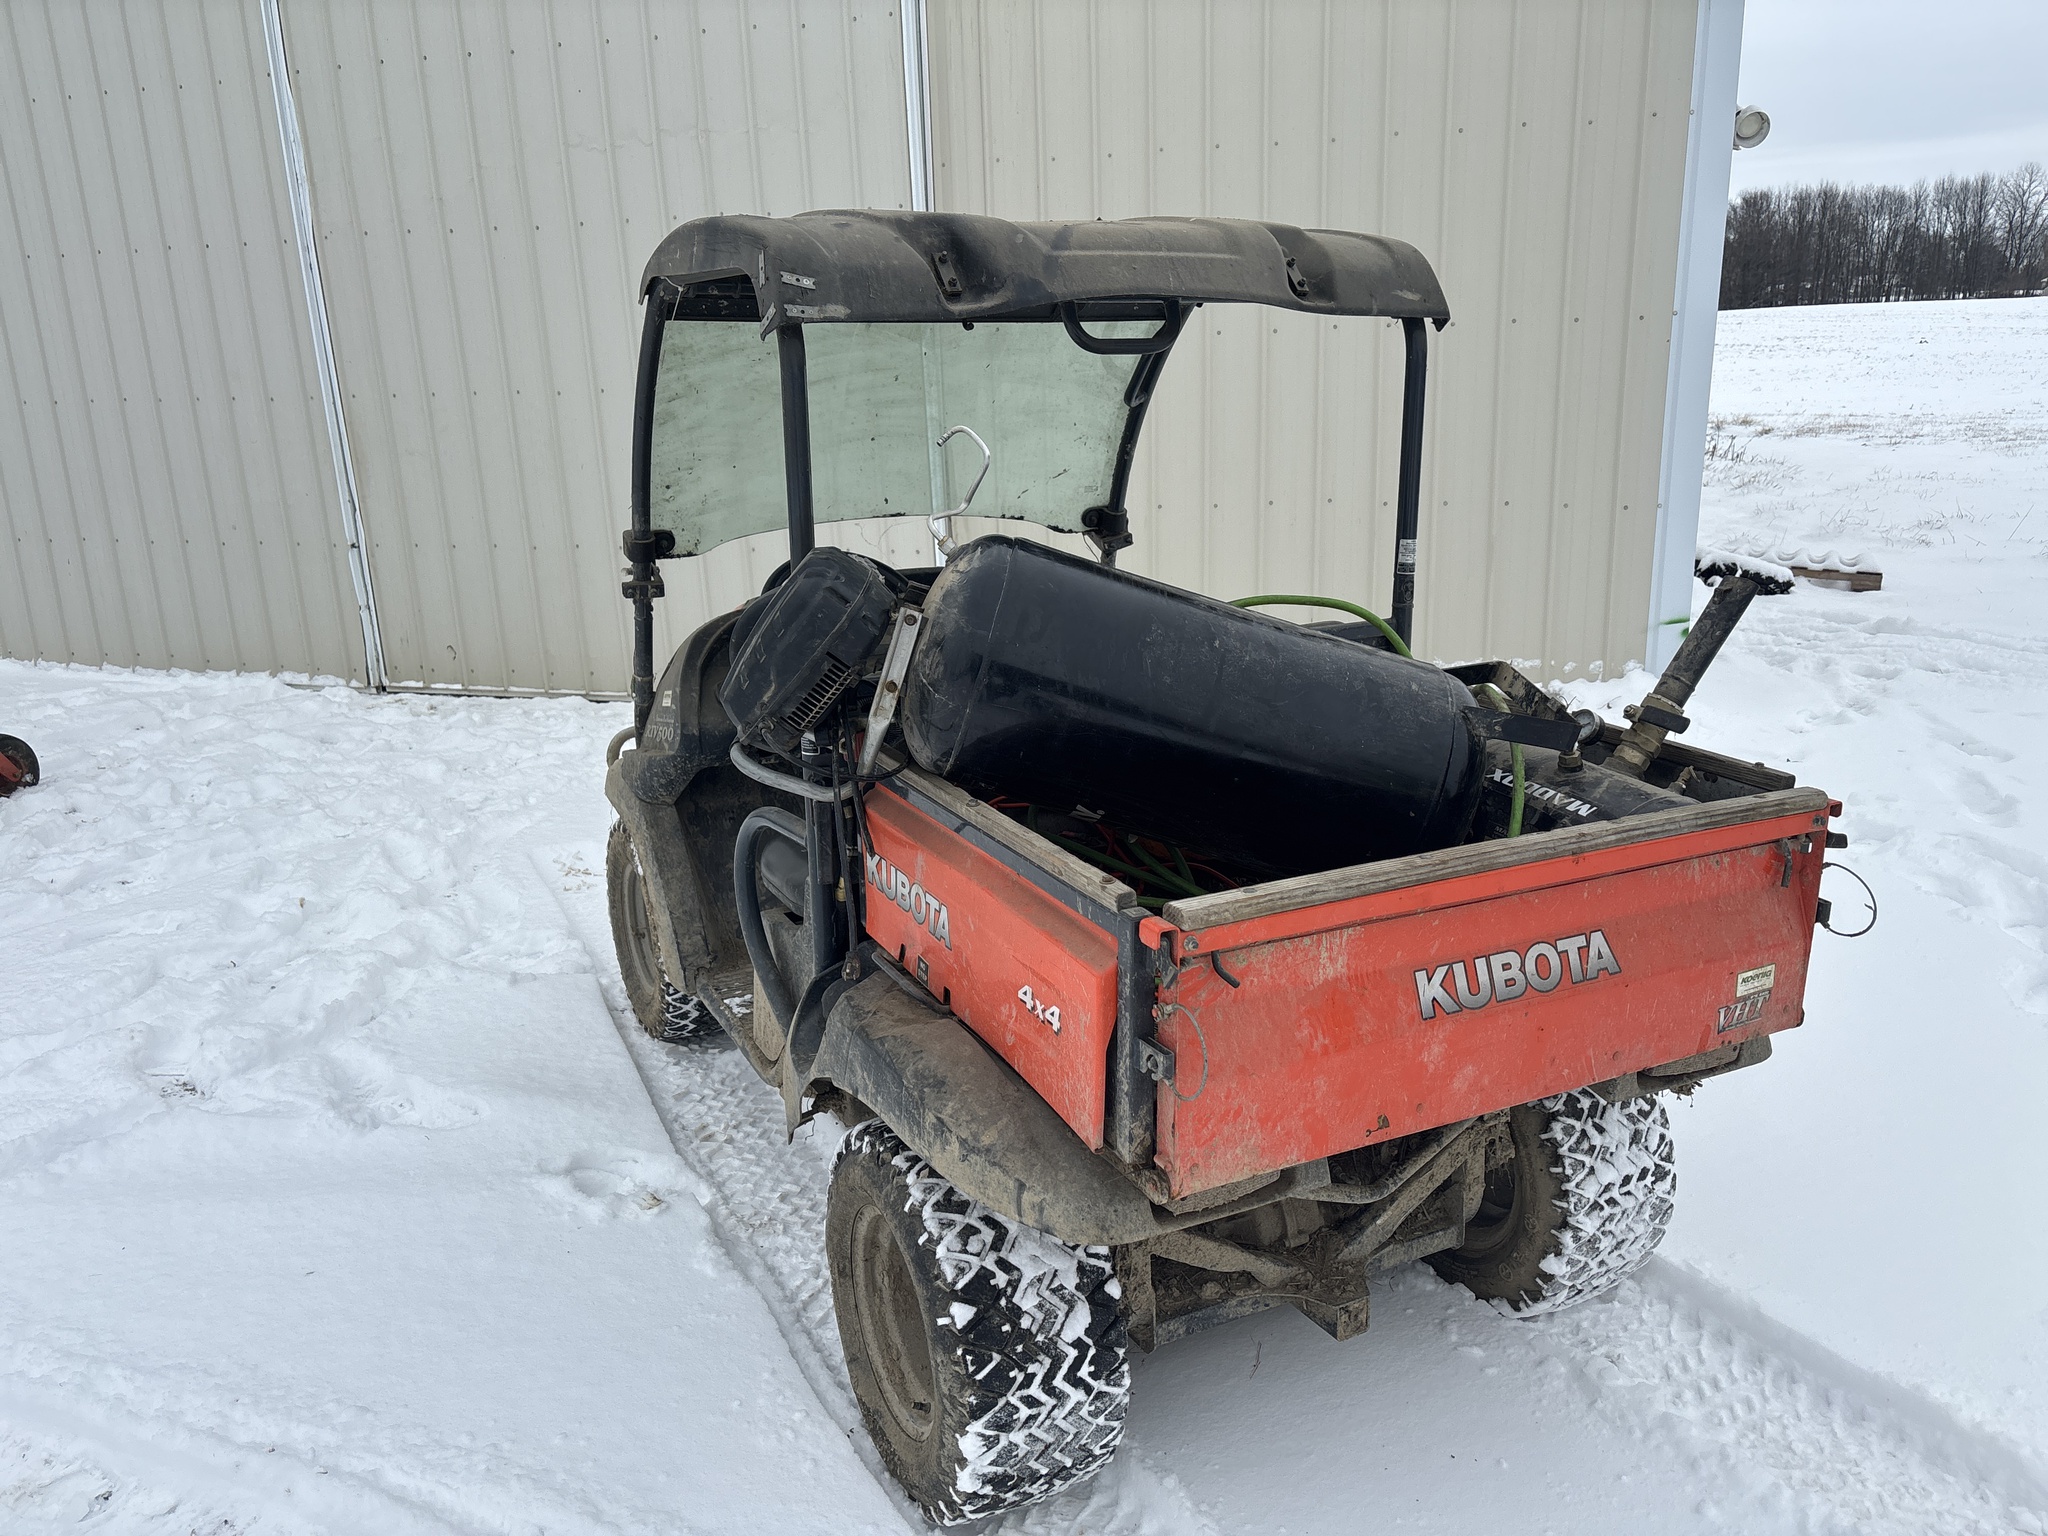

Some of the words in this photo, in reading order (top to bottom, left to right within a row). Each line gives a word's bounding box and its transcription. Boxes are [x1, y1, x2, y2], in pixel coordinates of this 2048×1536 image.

[866, 853, 952, 951] KUBOTA
[1414, 929, 1621, 1020] KUBOTA
[1017, 985, 1061, 1035] 4x4
[1718, 994, 1770, 1034] VHT
